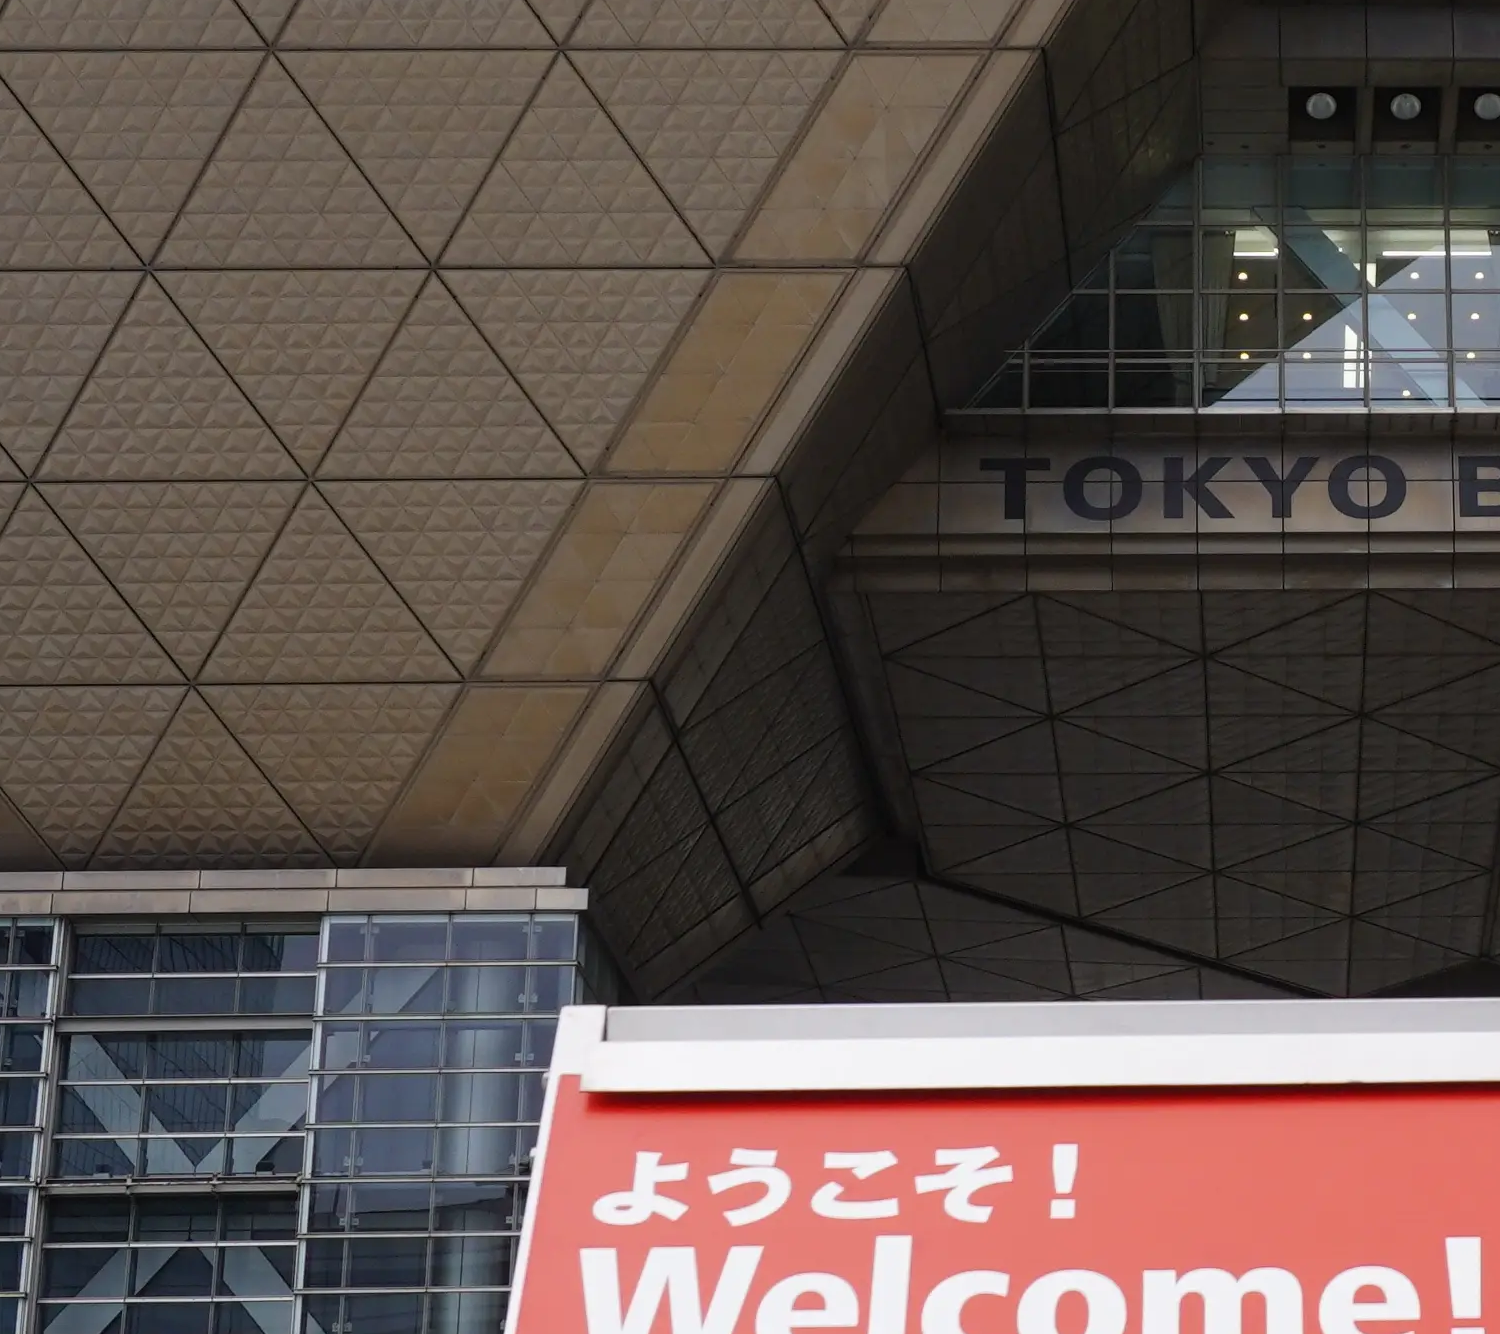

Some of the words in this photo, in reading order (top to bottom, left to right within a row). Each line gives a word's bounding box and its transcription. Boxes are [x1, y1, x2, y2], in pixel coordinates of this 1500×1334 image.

[979, 454, 1407, 522] TOKYO
[592, 1144, 1080, 1229] ようこそ！
